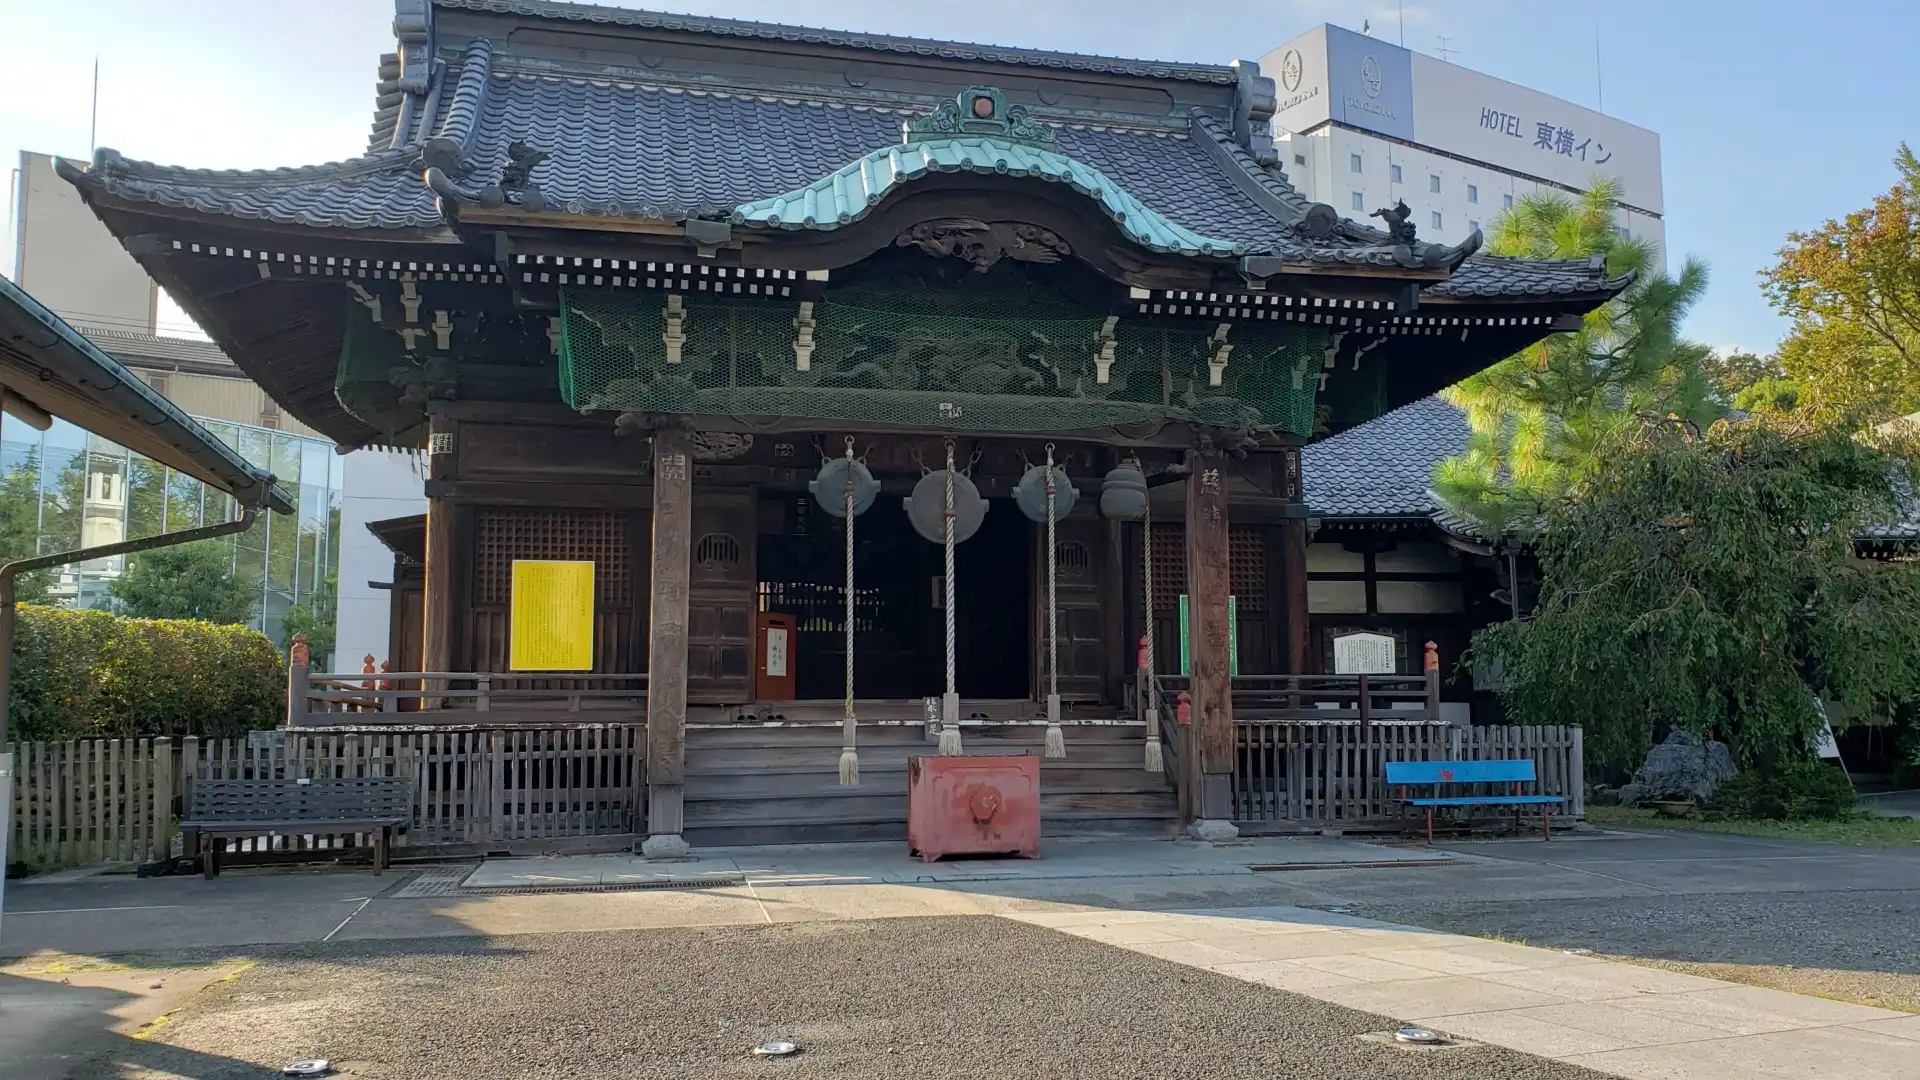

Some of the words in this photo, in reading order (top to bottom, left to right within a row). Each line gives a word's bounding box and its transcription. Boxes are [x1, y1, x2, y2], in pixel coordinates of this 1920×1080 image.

[1480, 107, 1522, 138] HOTEL
[1533, 121, 1612, 164] 東横イン
